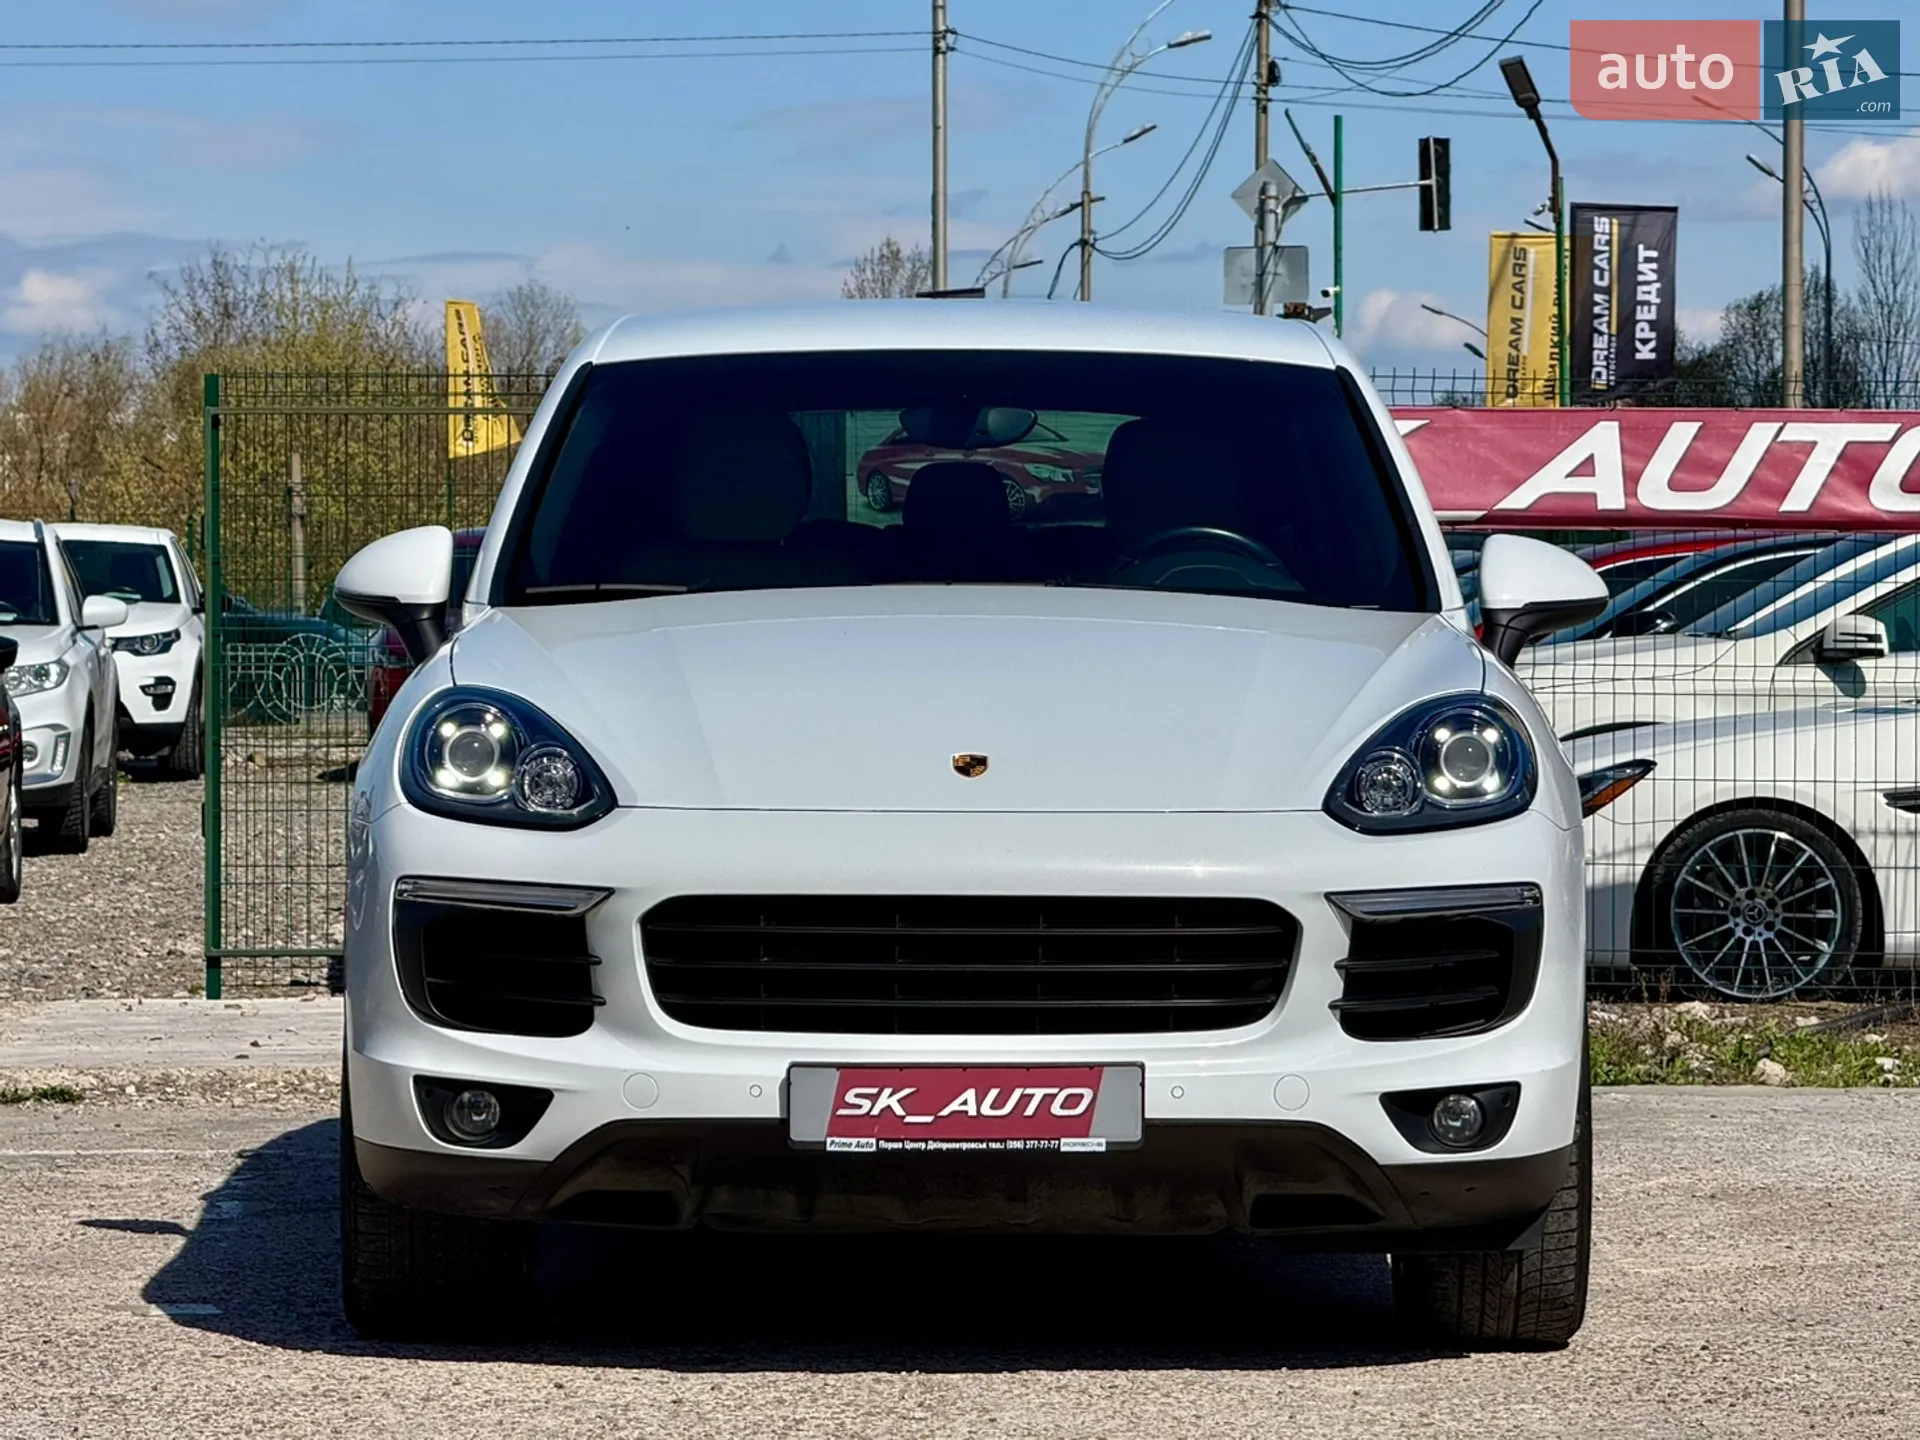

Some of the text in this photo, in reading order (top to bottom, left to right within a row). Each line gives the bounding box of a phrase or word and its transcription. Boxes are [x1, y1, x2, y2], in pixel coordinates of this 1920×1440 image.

[1593, 216, 1611, 287] CARS
[1511, 246, 1528, 310] CARS
[1635, 244, 1661, 360] КРЕДИТ
[835, 1086, 1095, 1124] SK_AUTO
[828, 1139, 875, 1150] Prime Auto
[904, 1140, 926, 1151] Центр
[1025, 1139, 1060, 1150] 377-77-77
